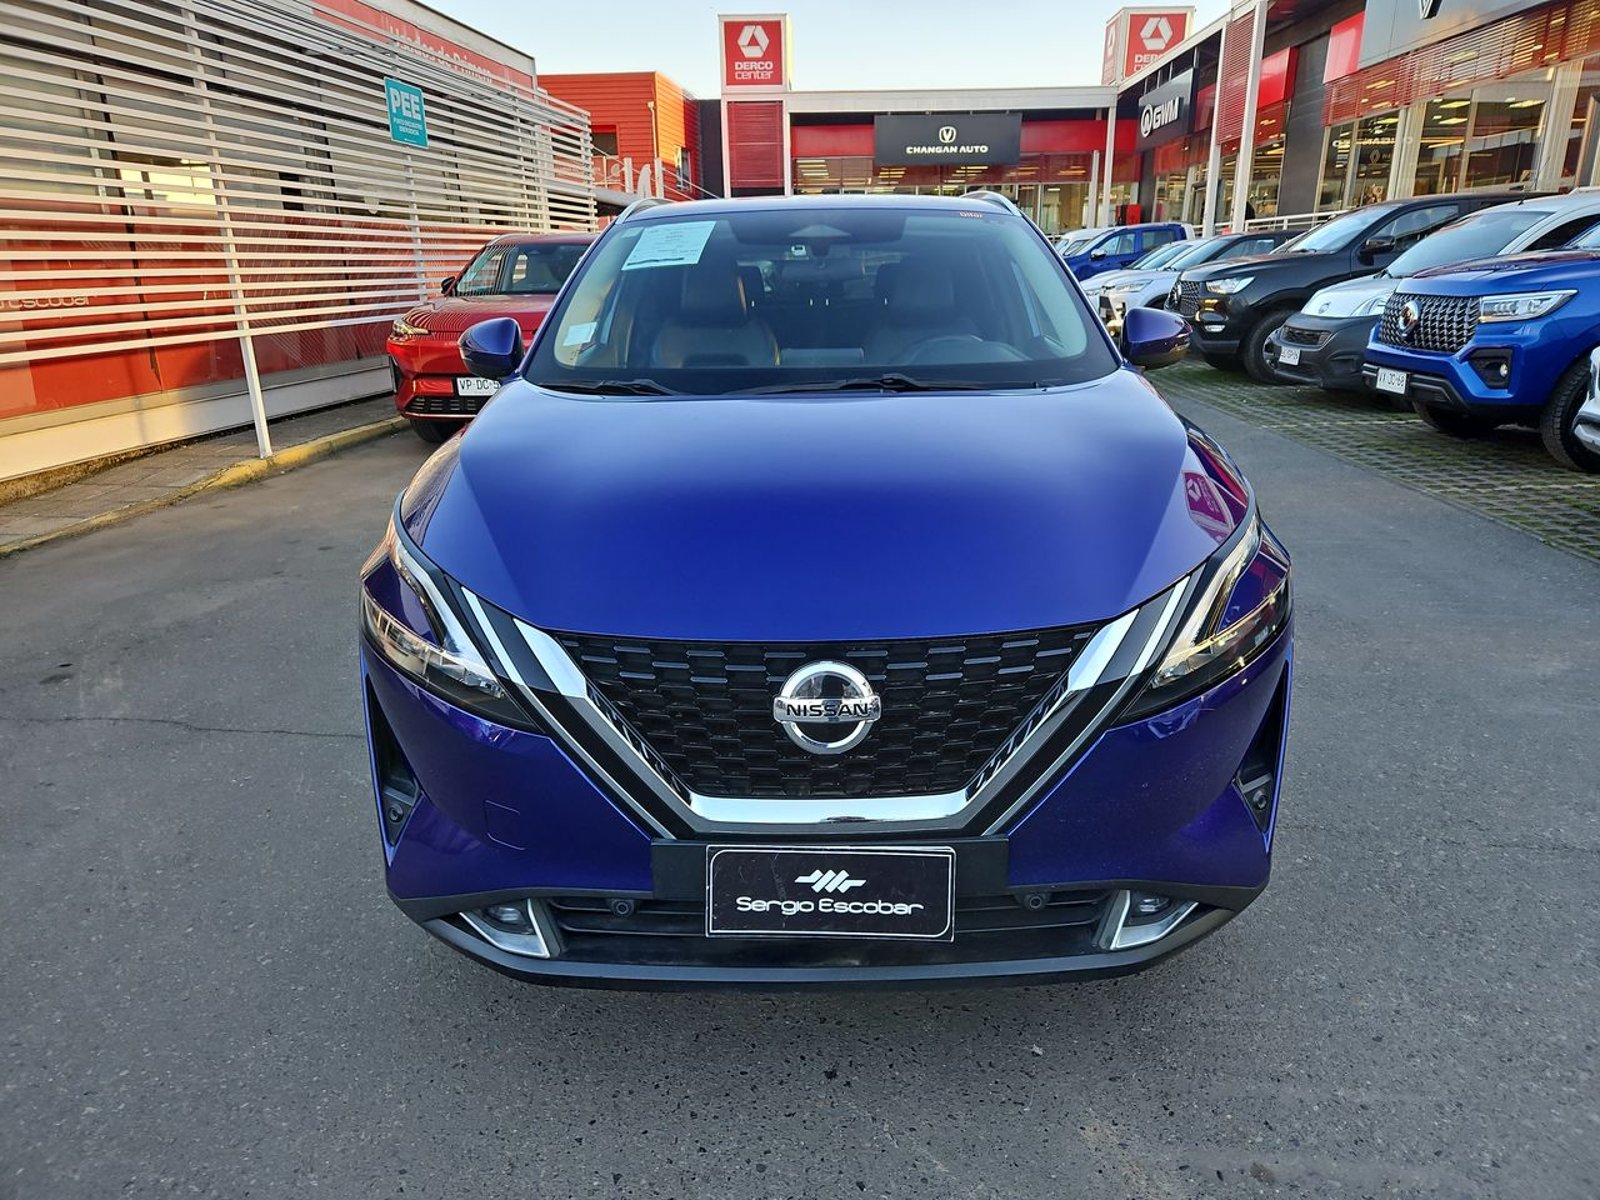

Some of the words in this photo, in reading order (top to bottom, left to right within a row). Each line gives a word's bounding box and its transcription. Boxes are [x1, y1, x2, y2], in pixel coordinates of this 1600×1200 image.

[734, 61, 774, 71] DERCO
[734, 71, 774, 80] center
[390, 87, 421, 120] PEE
[1152, 97, 1180, 130] GWM
[906, 145, 958, 154] CHANGAN
[959, 145, 989, 153] AUTO
[786, 704, 869, 717] NISSAN
[736, 896, 815, 916] Sergio
[818, 898, 925, 916] Escobar
